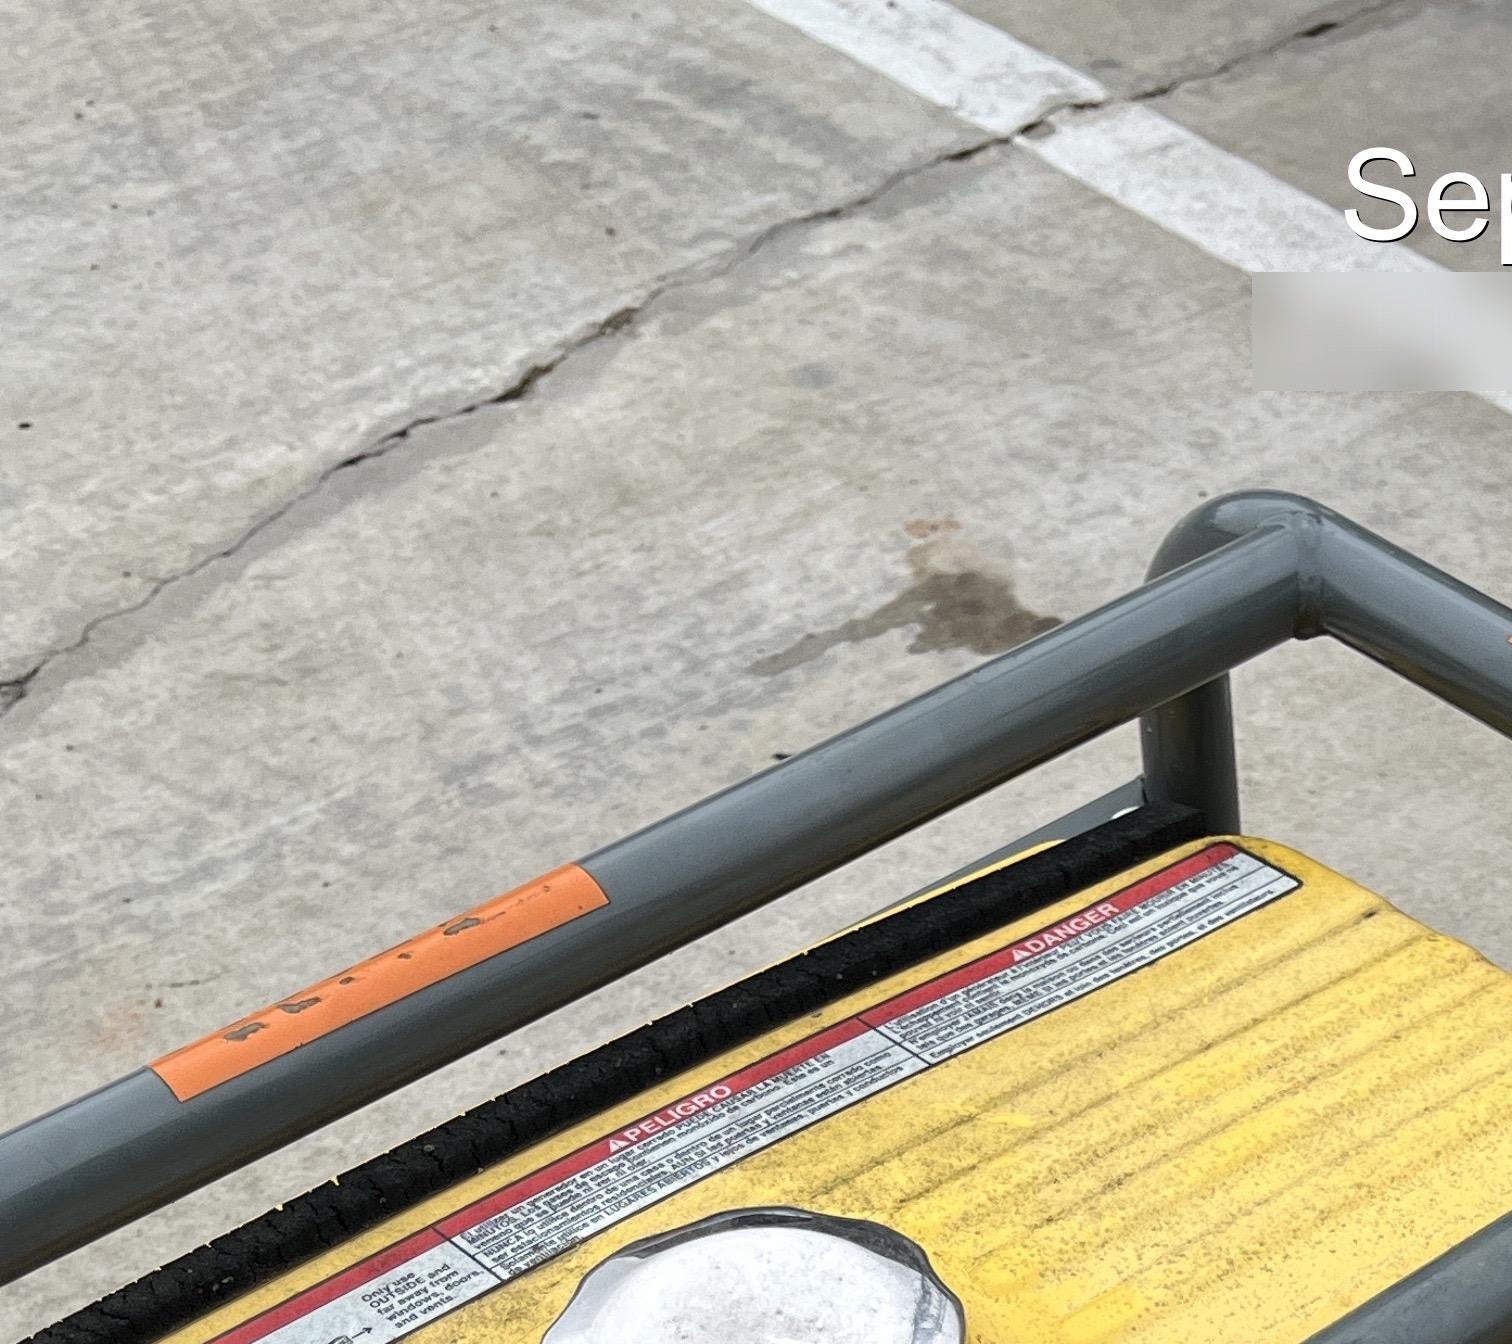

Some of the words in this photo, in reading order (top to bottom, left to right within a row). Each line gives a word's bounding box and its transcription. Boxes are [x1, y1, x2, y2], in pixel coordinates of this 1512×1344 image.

[1024, 903, 1119, 952] DANGER
[623, 1084, 732, 1141] PELIGRO
[361, 1285, 390, 1302] Only
[393, 1272, 415, 1285] use
[369, 1277, 425, 1307] OUTSIDE
[426, 1264, 450, 1277] and
[377, 1304, 394, 1314] far
[397, 1287, 428, 1304] away
[429, 1270, 458, 1286] from
[394, 1314, 417, 1327] and
